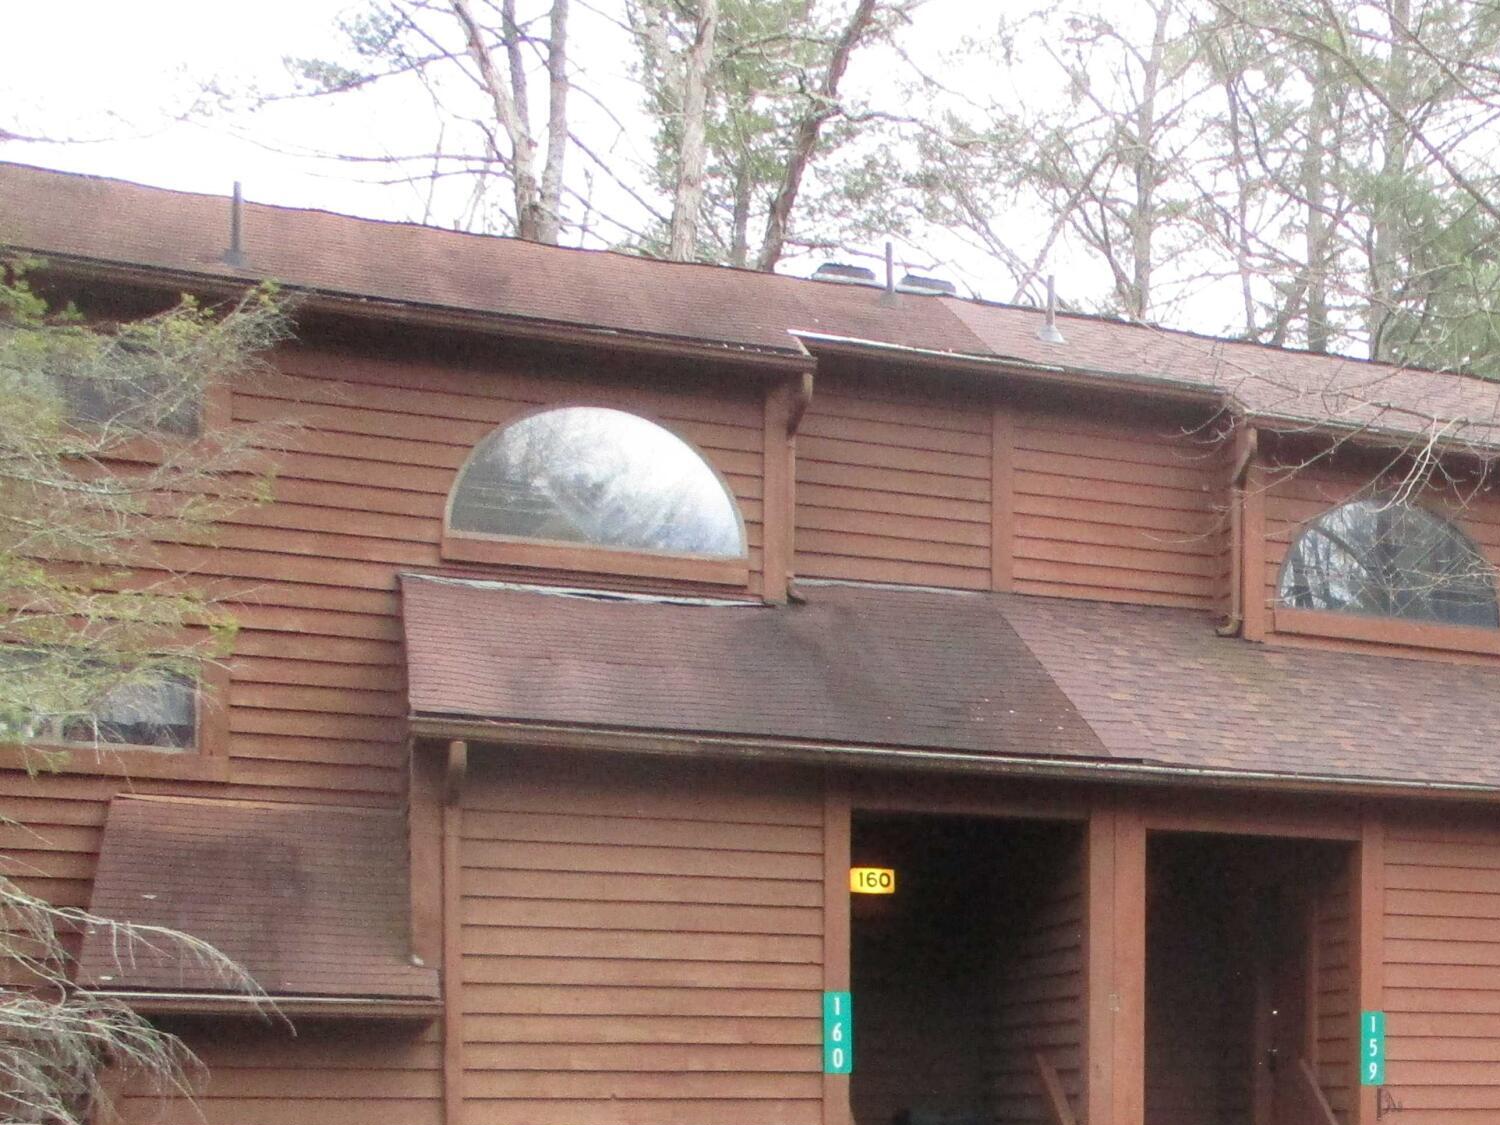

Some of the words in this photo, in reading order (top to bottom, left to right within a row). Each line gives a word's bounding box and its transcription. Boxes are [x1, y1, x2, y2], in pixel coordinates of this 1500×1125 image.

[859, 872, 891, 888] 160
[832, 997, 844, 1068] 160
[1368, 1016, 1378, 1081] 159
